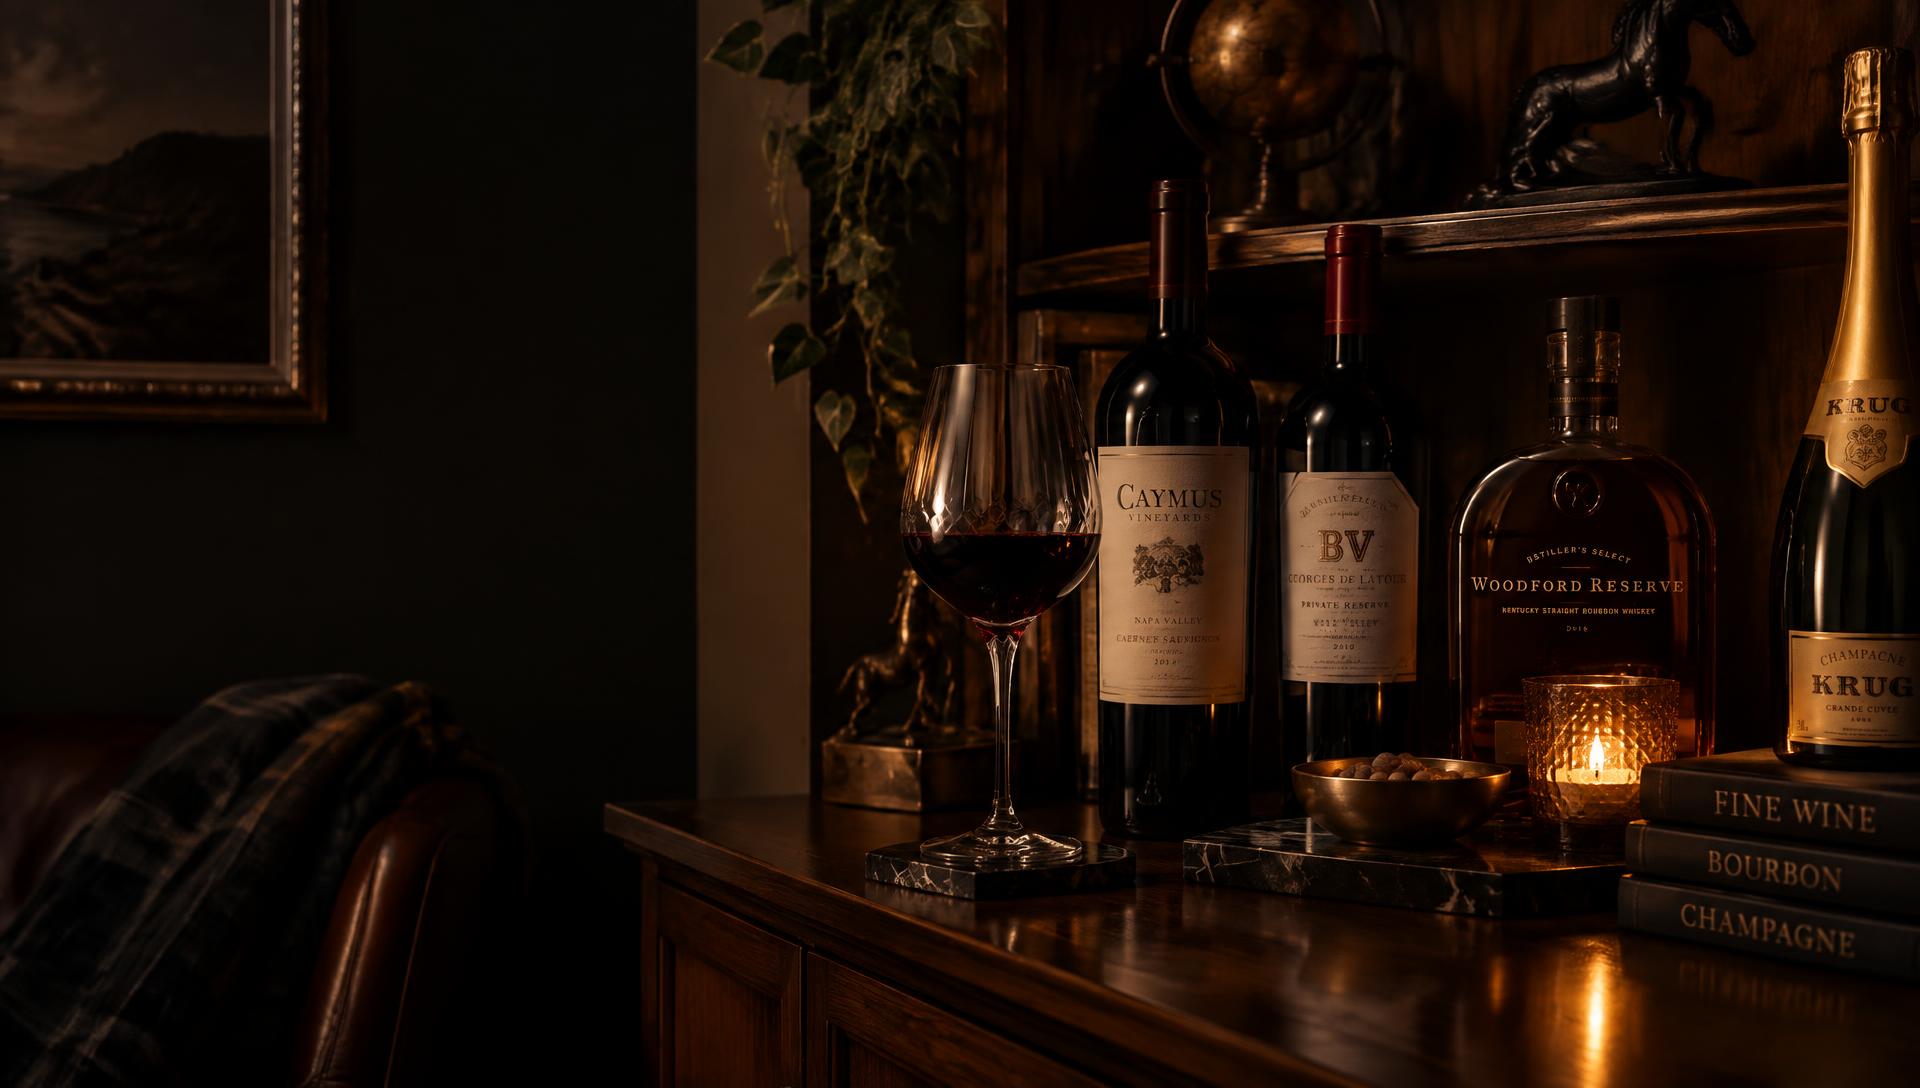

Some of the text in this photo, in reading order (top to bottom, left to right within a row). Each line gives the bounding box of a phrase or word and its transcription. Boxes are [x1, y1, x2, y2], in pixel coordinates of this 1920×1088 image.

[1826, 397, 1912, 416] KRUG
[1117, 483, 1223, 510] CAYMUS
[1128, 513, 1211, 522] VINEYARDS
[1317, 529, 1375, 563] BV
[1592, 547, 1632, 565] SELECT
[1340, 575, 1356, 583] DE
[1472, 576, 1685, 593] WOODFORD RESERVE
[1301, 600, 1339, 609] PRIVATE
[1502, 606, 1539, 615] KENTUCKY
[1542, 607, 1579, 615] STRAIGHT
[1134, 616, 1202, 625] NAPA VALLEY
[1820, 648, 1906, 667] CHAMPAGNE
[1812, 674, 1914, 698] KRUG
[1825, 704, 1863, 713] GRANDE
[1714, 789, 1878, 834] FINE WINE
[1707, 850, 1843, 894] BOURBON
[1680, 903, 1857, 958] CHAMPAGNE
